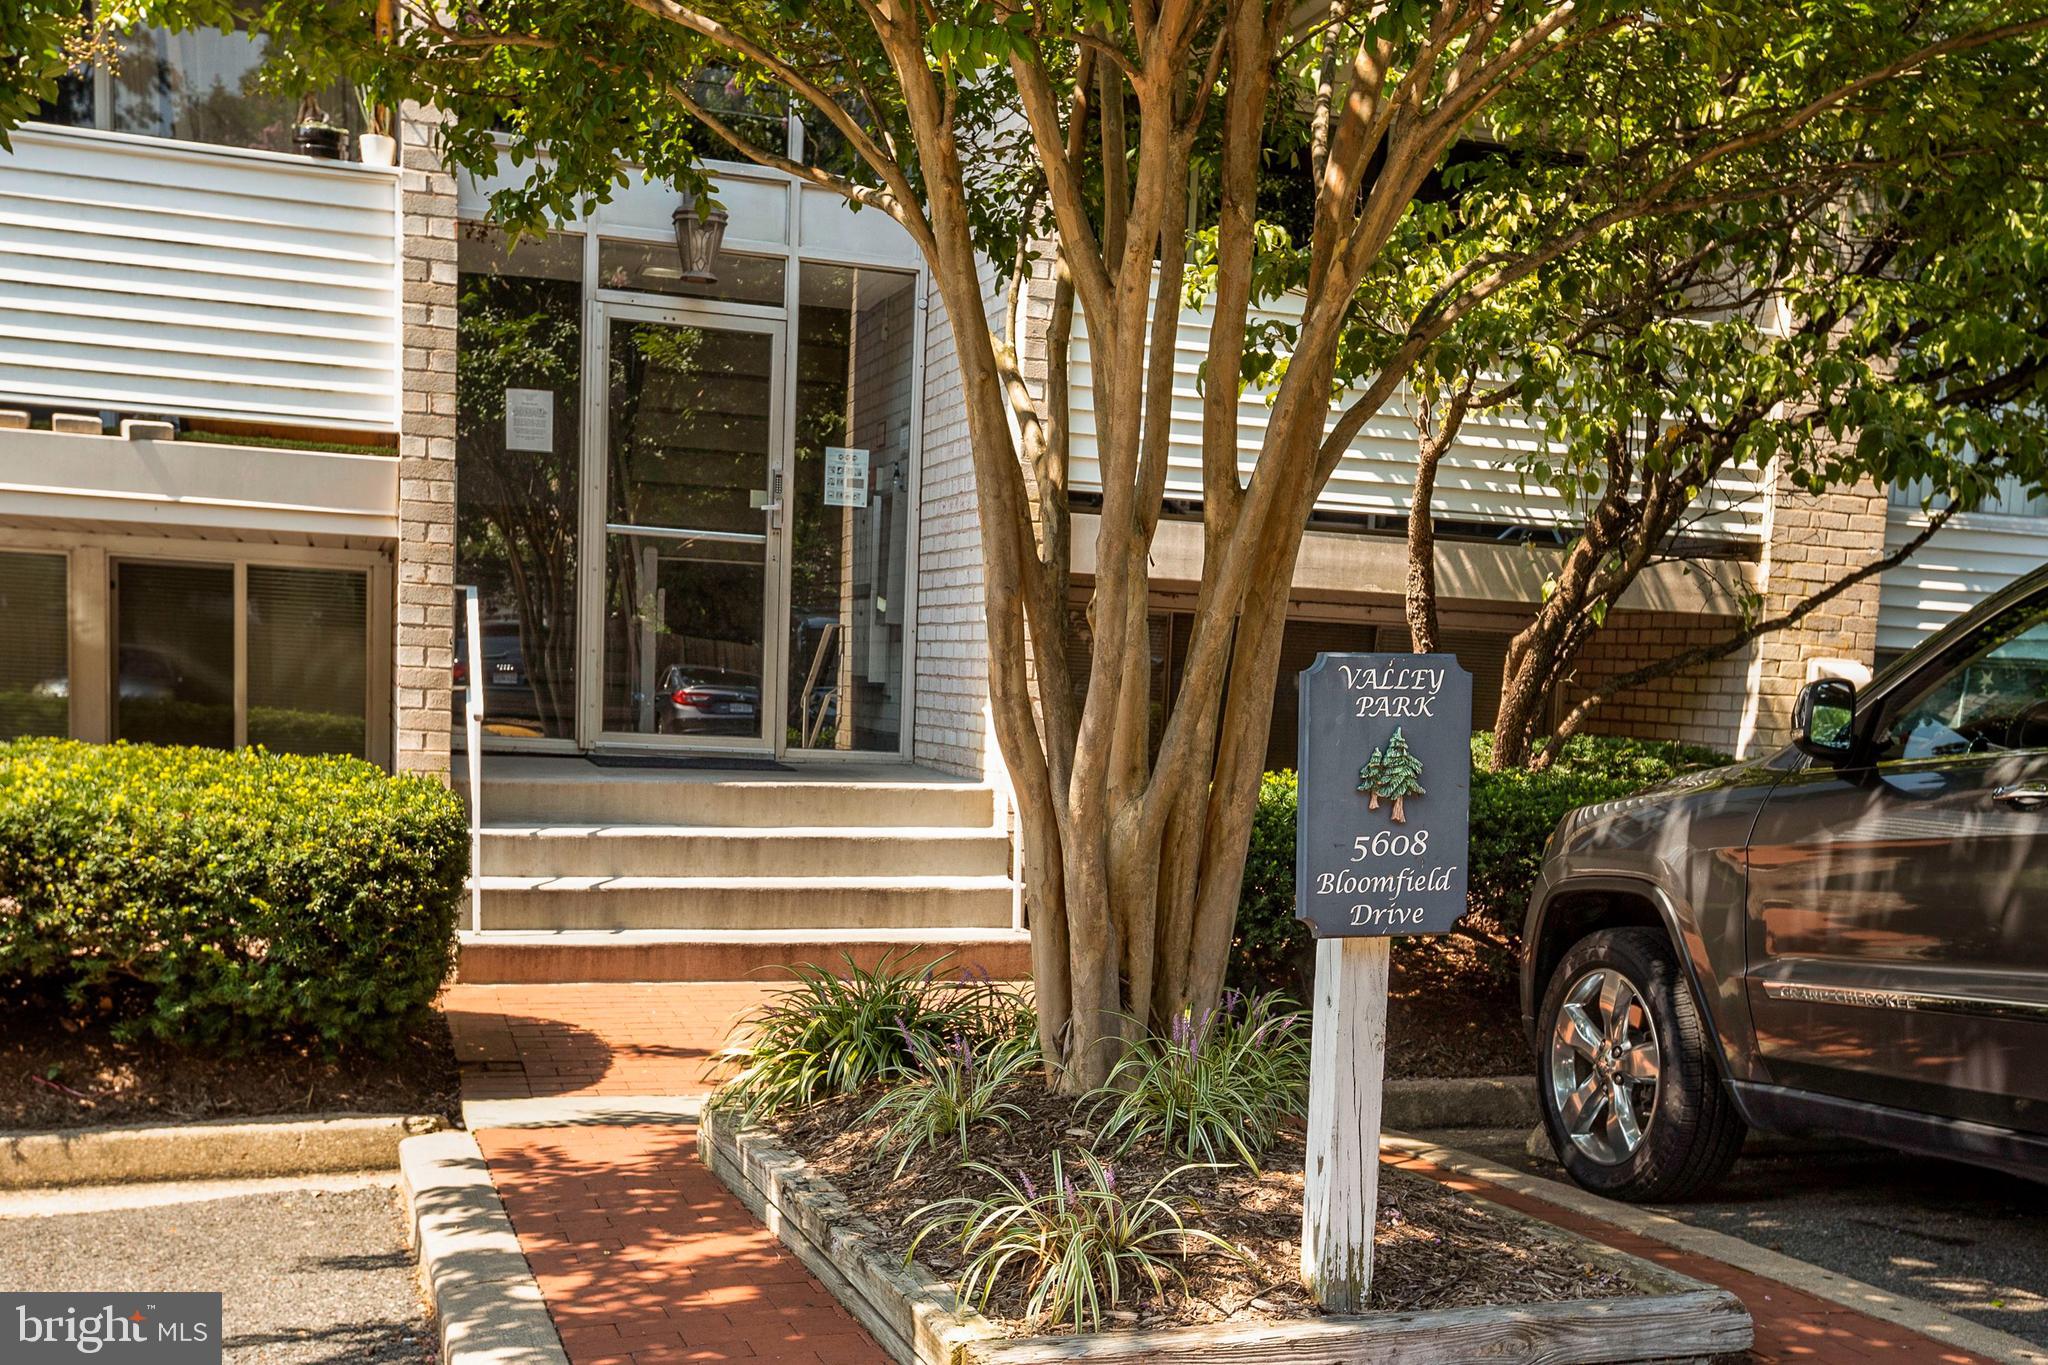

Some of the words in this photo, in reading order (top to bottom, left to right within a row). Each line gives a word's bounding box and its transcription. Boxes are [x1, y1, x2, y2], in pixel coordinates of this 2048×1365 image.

[1339, 665, 1445, 694] VALLEY
[1355, 696, 1435, 718] PARK
[1350, 830, 1429, 862] 5608
[1316, 866, 1457, 901] Bloomfield
[1350, 902, 1424, 926] Drive
[1780, 987, 1830, 1001] GRAND
[1834, 990, 1918, 1009] CHEROKEE
